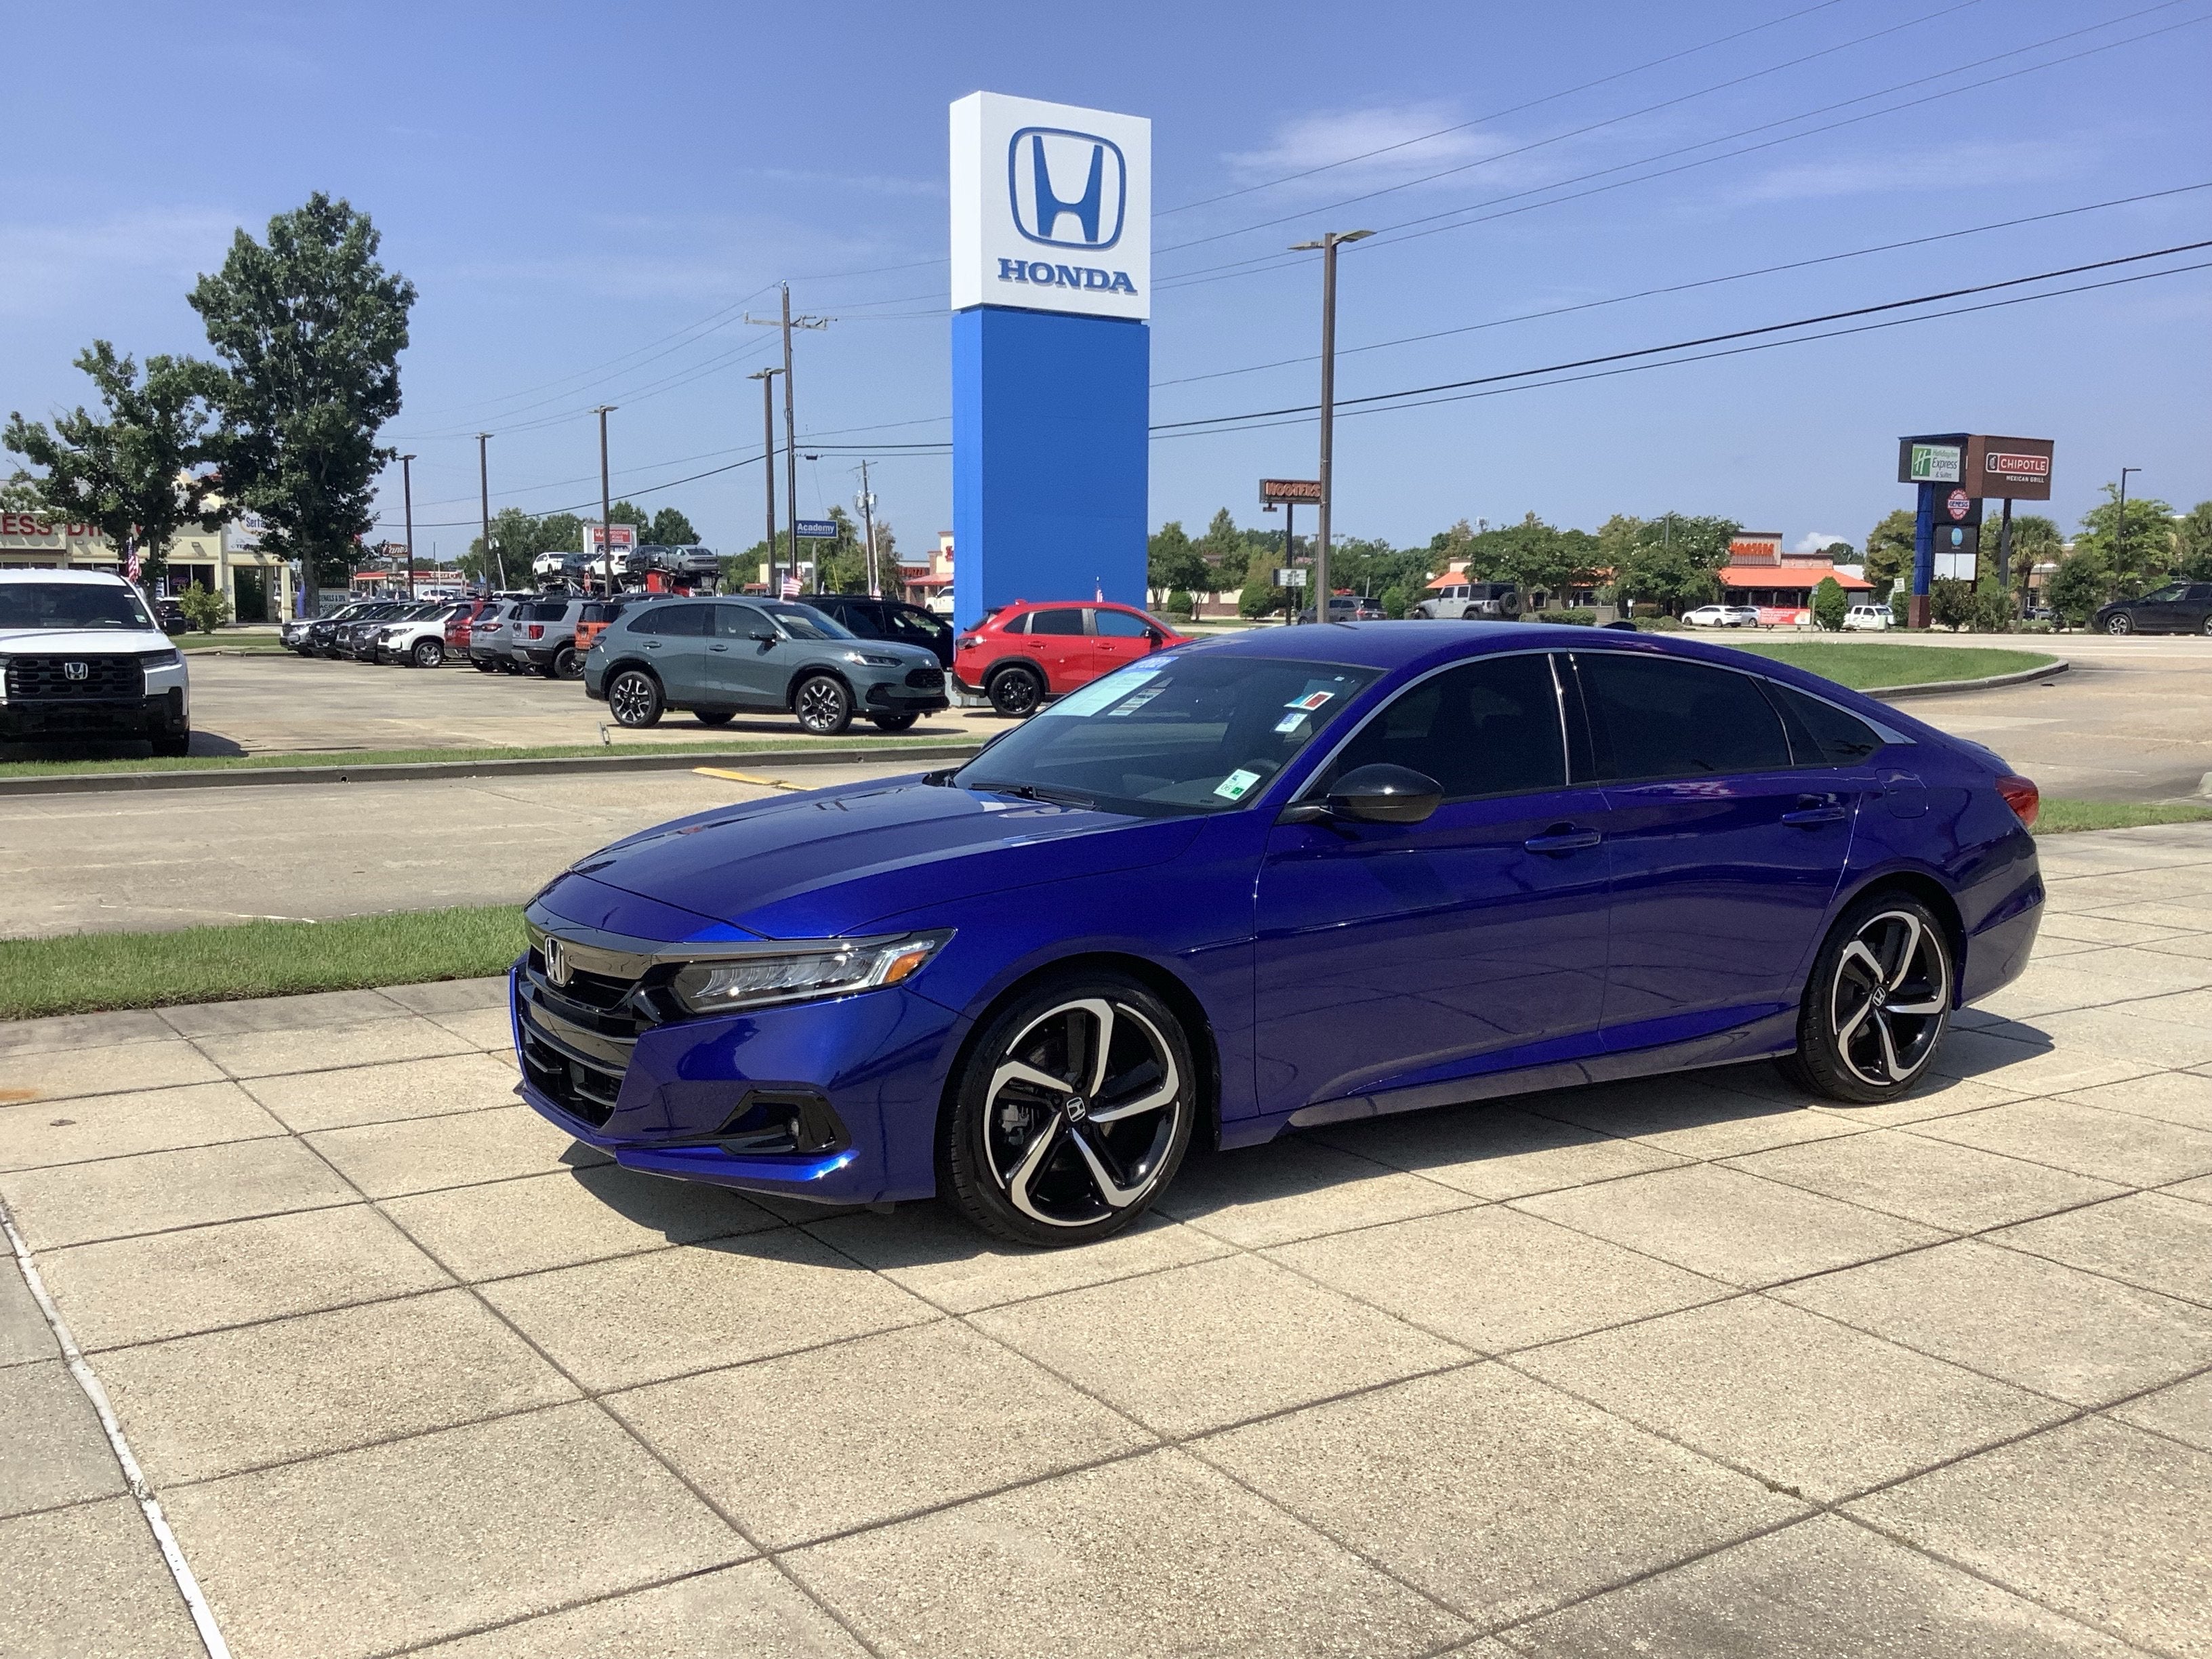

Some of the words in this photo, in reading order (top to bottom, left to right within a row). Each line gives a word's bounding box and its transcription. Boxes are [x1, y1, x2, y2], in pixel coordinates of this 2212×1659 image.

[998, 258, 1139, 295] HONDA
[1933, 448, 1950, 459] Holiday
[1932, 457, 1958, 470] Express
[2001, 458, 2046, 471] CHIPOTLE
[1266, 482, 1321, 497] HOOTERS
[798, 523, 835, 534] Academy
